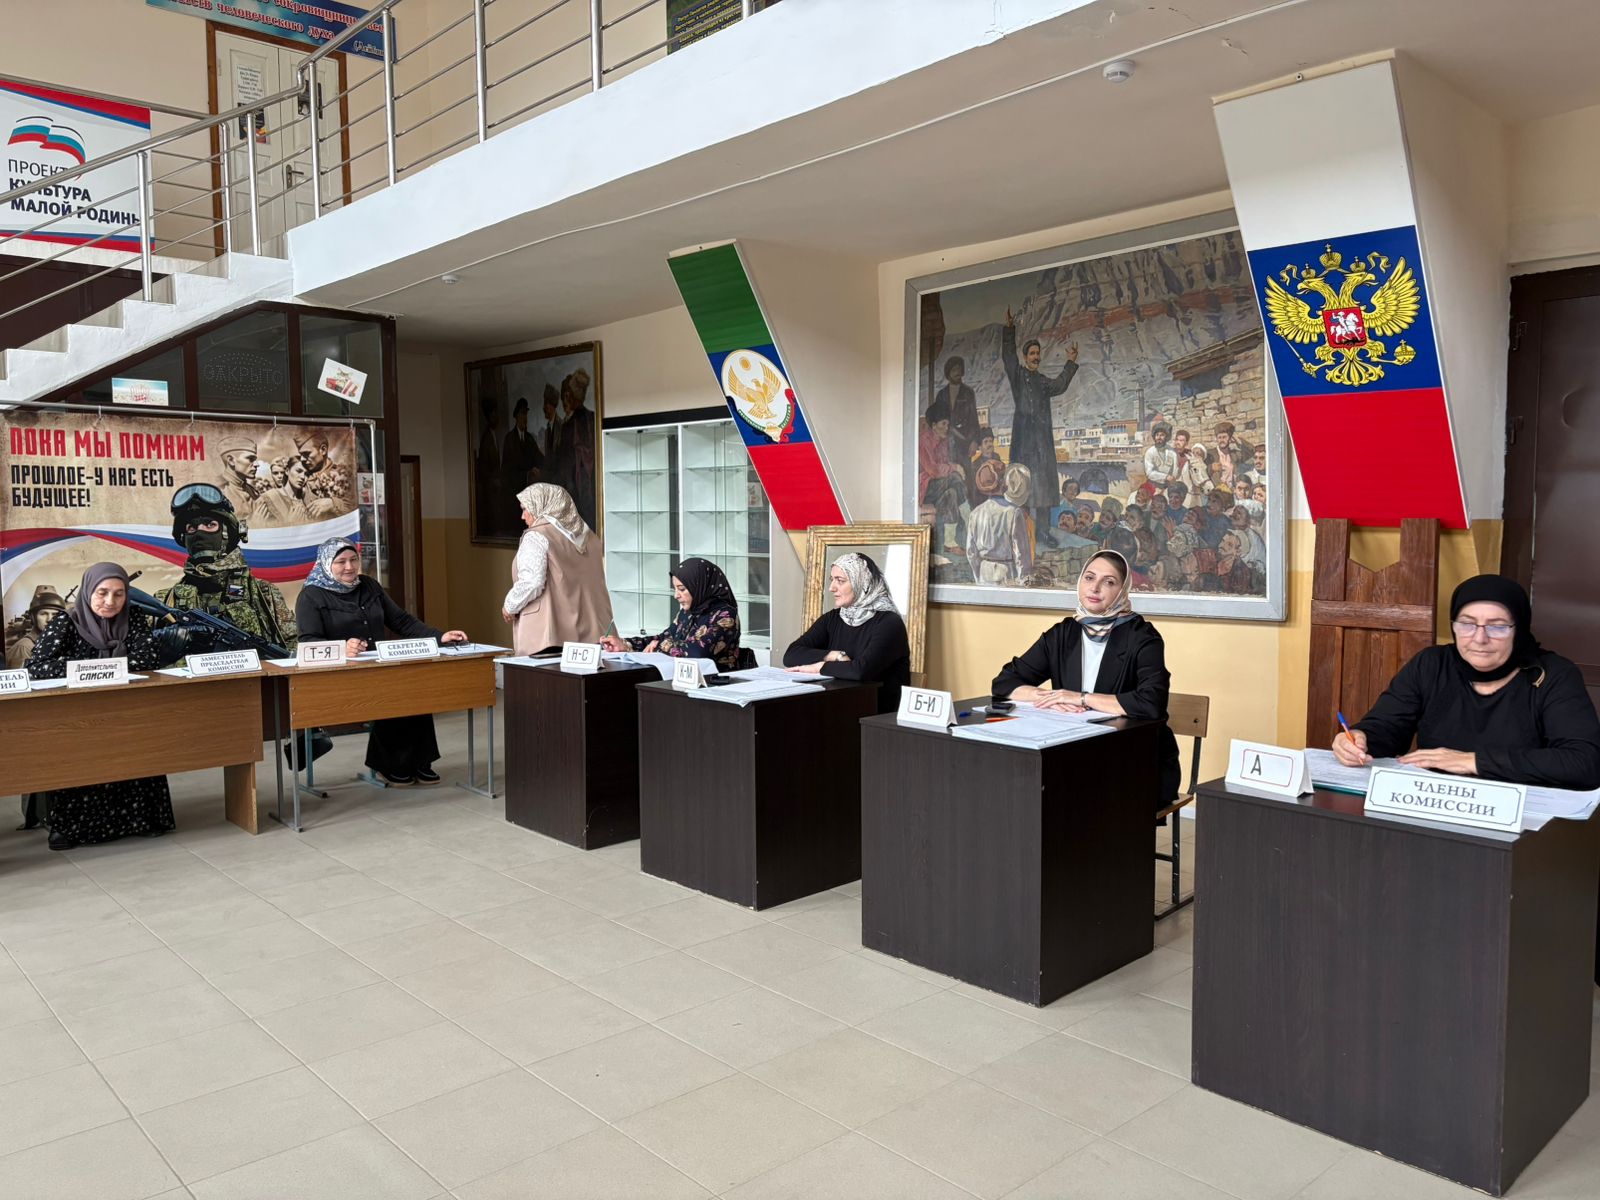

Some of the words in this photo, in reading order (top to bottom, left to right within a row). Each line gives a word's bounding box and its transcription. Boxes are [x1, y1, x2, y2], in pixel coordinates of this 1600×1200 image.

[8, 159, 68, 177] ПРОЕК
[11, 198, 72, 217] МАЛОЙ
[10, 427, 66, 456] ПОКА
[74, 430, 111, 458] МЫ
[119, 432, 205, 461] ПОМНИМ
[109, 468, 137, 487] НАС
[142, 468, 174, 487] ЕСТЬ
[12, 488, 91, 509] БУДУЩЕЕ!
[310, 647, 332, 659] Т-Я
[387, 642, 428, 650] СЕКРЕТАРЬ
[388, 648, 430, 657] КОМИССИИ
[572, 649, 588, 661] Н-С
[79, 671, 114, 681] СПИСКИ
[208, 664, 245, 672] КОМИССИИ
[914, 694, 936, 713] Б-И
[1250, 754, 1262, 776] А
[1414, 780, 1477, 799] ЧЛЕНЫ
[1390, 792, 1496, 817] КОМИССИИ
